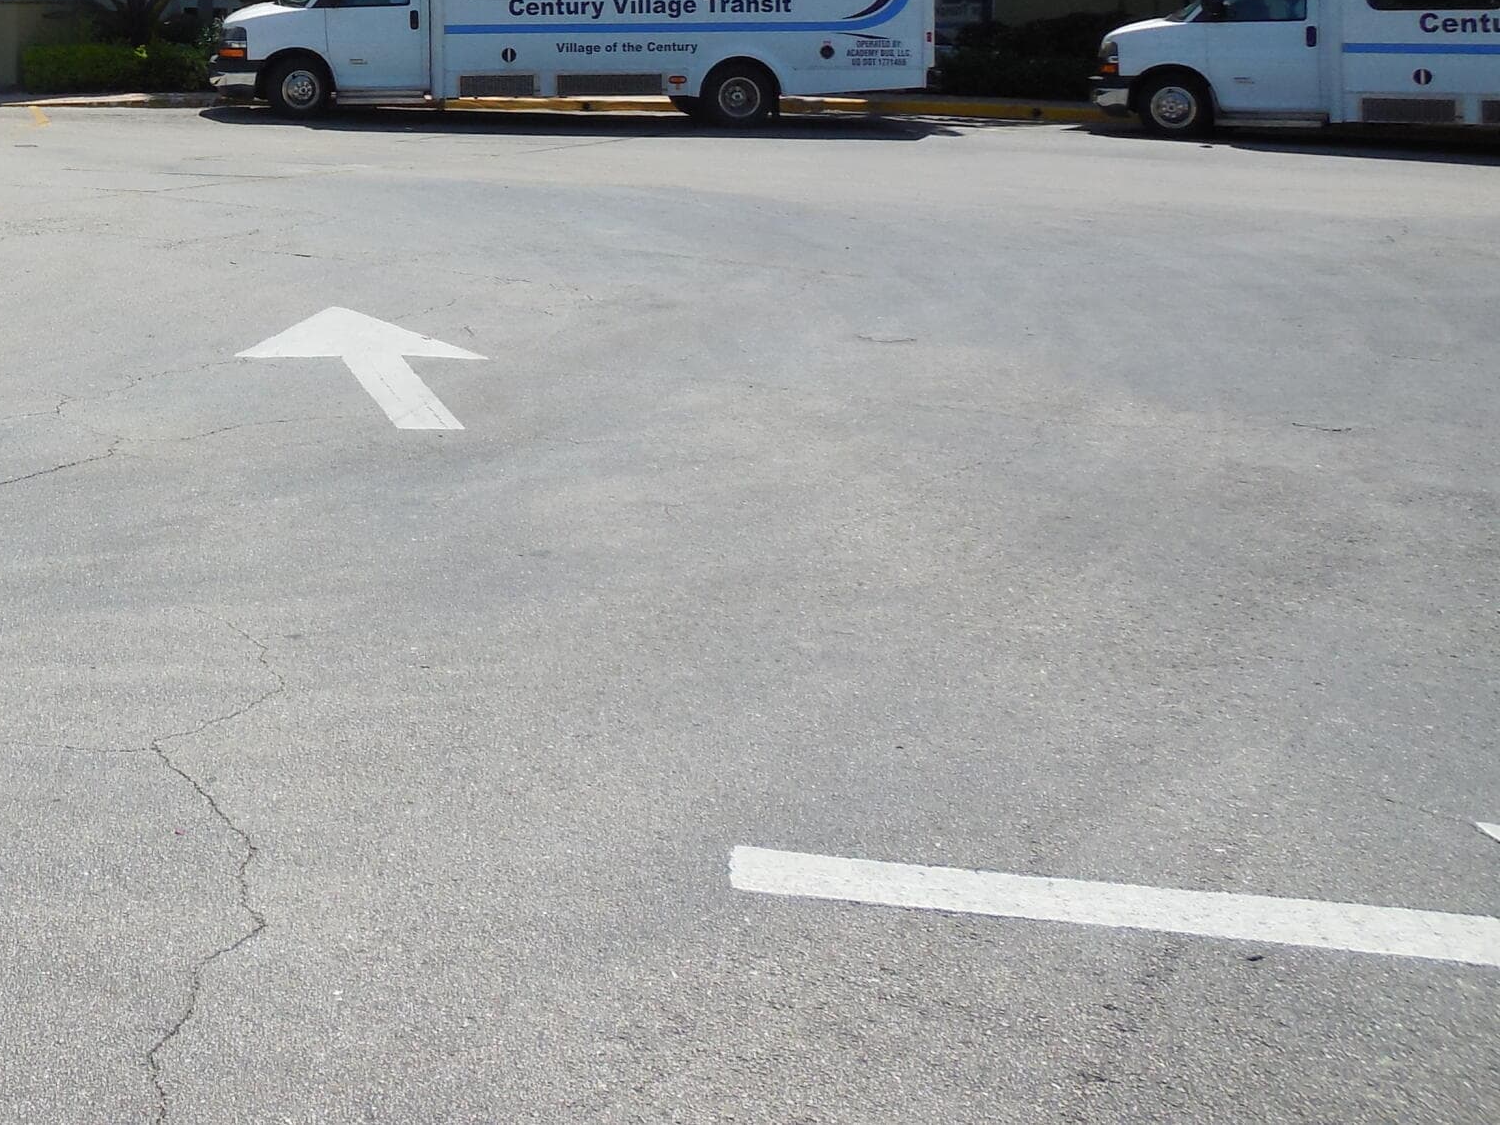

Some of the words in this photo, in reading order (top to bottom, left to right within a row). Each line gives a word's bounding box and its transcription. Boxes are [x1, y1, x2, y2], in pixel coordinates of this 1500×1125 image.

[556, 42, 601, 55] Village
[604, 42, 618, 53] of
[622, 42, 643, 53] the
[646, 41, 698, 54] Century
